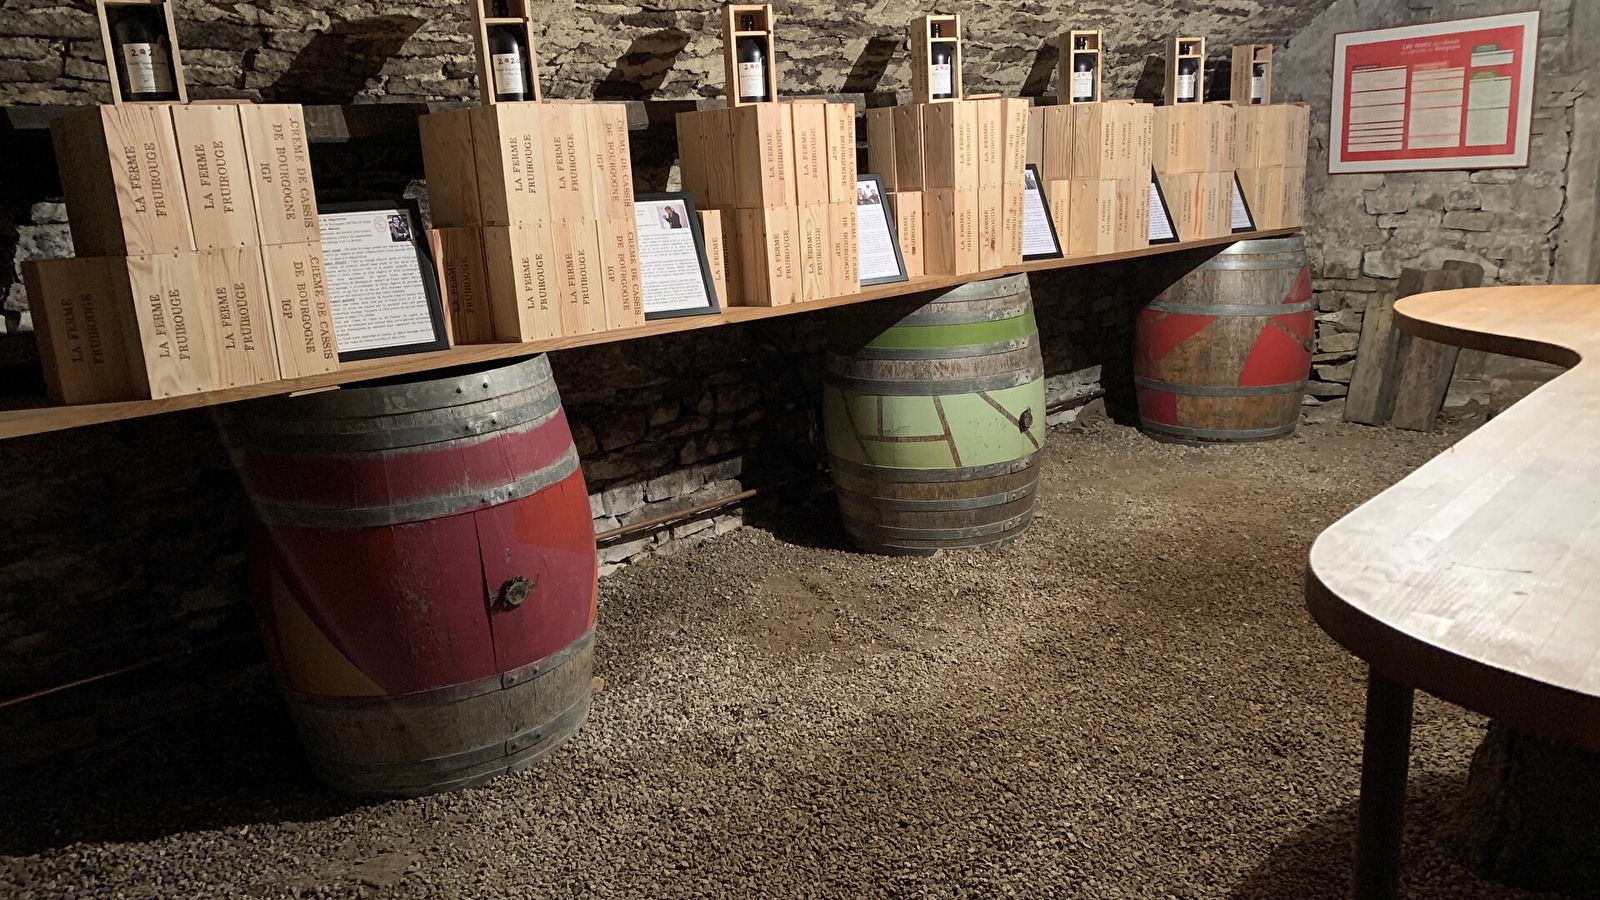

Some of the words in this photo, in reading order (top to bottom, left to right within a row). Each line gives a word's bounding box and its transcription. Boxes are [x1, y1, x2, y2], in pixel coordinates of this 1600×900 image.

[272, 124, 284, 140] DE
[606, 123, 613, 136] DE
[617, 120, 626, 154] CREME
[840, 119, 845, 130] DE
[290, 120, 305, 162] CREME
[510, 137, 521, 173] FERME
[554, 136, 564, 172] FERME
[776, 129, 784, 181] FRUIROUGE
[849, 147, 854, 159] DE
[125, 146, 142, 190] FERME
[194, 144, 211, 187] FERME
[524, 134, 536, 194] FRUIROUGE
[567, 134, 578, 192] FRUIROUGE
[620, 158, 628, 171] DE
[804, 164, 809, 176] LA
[960, 154, 964, 164] LA
[985, 152, 989, 162] LA
[144, 142, 168, 218] FRUIROUGE
[214, 140, 234, 214] FRUIROUGE
[260, 162, 272, 184] IGP
[276, 146, 296, 220] BOURGOGNE
[296, 168, 307, 184] DE
[515, 178, 523, 192] LA
[559, 176, 566, 190] LA
[608, 142, 619, 202] BOURGOGNE
[769, 166, 775, 178] LA
[134, 196, 146, 214] LA
[204, 193, 214, 210] LA
[622, 174, 631, 208] CASSIS
[300, 186, 314, 228] CASSIS
[843, 217, 847, 227] DE
[616, 235, 623, 249] DE
[627, 231, 637, 265] CREME
[712, 237, 720, 266] FERME
[773, 234, 782, 262] FERME
[783, 230, 792, 279] FRUIROUGE
[852, 243, 857, 254] DE
[905, 244, 908, 253] LA
[961, 241, 965, 250] LA
[293, 261, 304, 277] DE
[309, 257, 324, 298] CREME
[448, 260, 458, 290] FERME
[522, 257, 534, 292] FERME
[535, 253, 548, 311] FRUIROUGE
[564, 253, 577, 289] FERME
[578, 250, 590, 306] FRUIROUGE
[607, 266, 615, 282] IGP
[618, 254, 630, 311] BOURGOGNE
[631, 268, 638, 281] DE
[715, 270, 721, 281] LA
[776, 266, 782, 278] LA
[809, 263, 814, 274] LA
[461, 257, 474, 314] FRUIROUGE
[570, 291, 578, 304] LA
[216, 287, 233, 328] FERME
[282, 300, 293, 319] IGP
[316, 302, 326, 317] DE
[453, 298, 460, 313] LA
[527, 296, 535, 310] LA
[632, 284, 641, 316] CASSIS
[62, 298, 80, 340] FERME
[150, 294, 167, 335] FERME
[169, 290, 190, 360] FRUIROUGE
[234, 283, 255, 351] FRUIROUGE
[296, 283, 316, 354] BOURGOGNE
[83, 294, 104, 364] FRUIROUGE
[226, 333, 236, 350] LA
[319, 320, 333, 360] CASSIS
[72, 344, 83, 362] LA
[160, 341, 170, 359] LA
